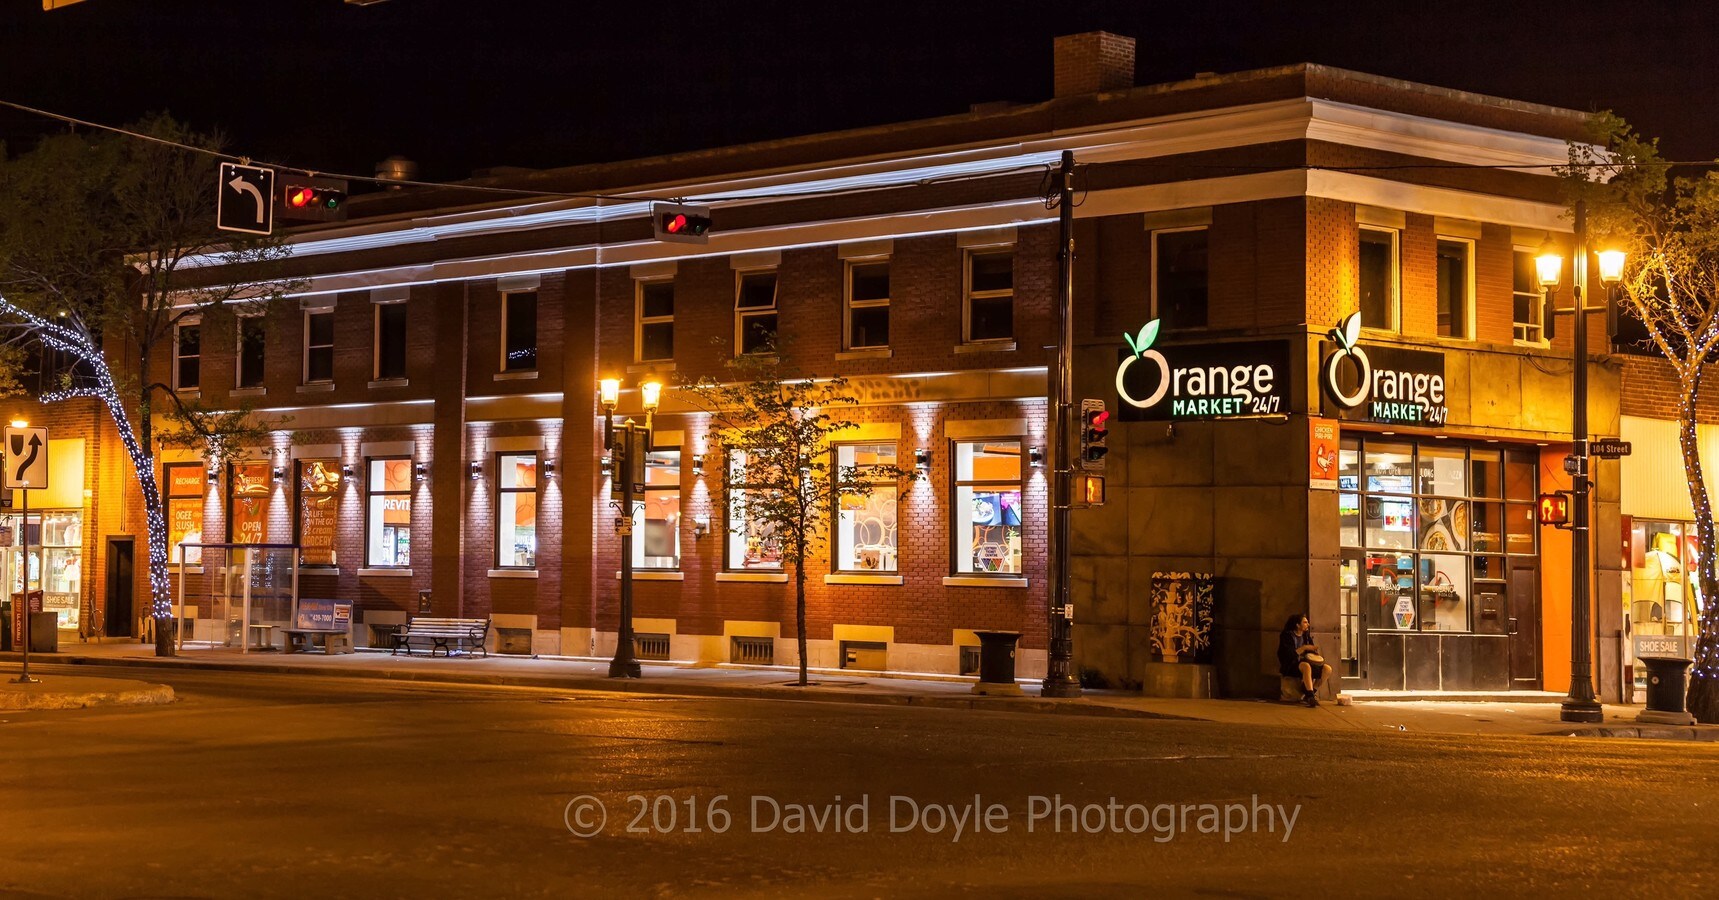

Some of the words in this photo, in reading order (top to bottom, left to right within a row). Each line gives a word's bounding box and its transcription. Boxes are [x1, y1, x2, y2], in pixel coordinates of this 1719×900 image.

[1116, 349, 1274, 409] Orange
[1329, 346, 1444, 412] Orange
[1173, 398, 1243, 415] MARKET
[1252, 394, 1280, 414] 24/7
[1373, 401, 1423, 421] MARKET
[1429, 406, 1448, 424] 24/7
[1606, 445, 1628, 453] Street
[176, 477, 200, 485] RECHARGE
[312, 510, 324, 518] LIFE
[1558, 501, 1566, 517] 4
[176, 510, 192, 520] OGEE
[176, 521, 194, 530] SLUSH
[242, 521, 262, 532] OPEN
[315, 518, 326, 526] THE
[326, 518, 334, 526] GO
[312, 526, 333, 535] cream
[240, 532, 262, 544] 24/7
[302, 536, 333, 546] GROCERY
[46, 596, 60, 604] SHOE
[60, 596, 74, 604] SALE
[1640, 641, 1659, 652] SHOE
[1660, 641, 1678, 652] SALE
